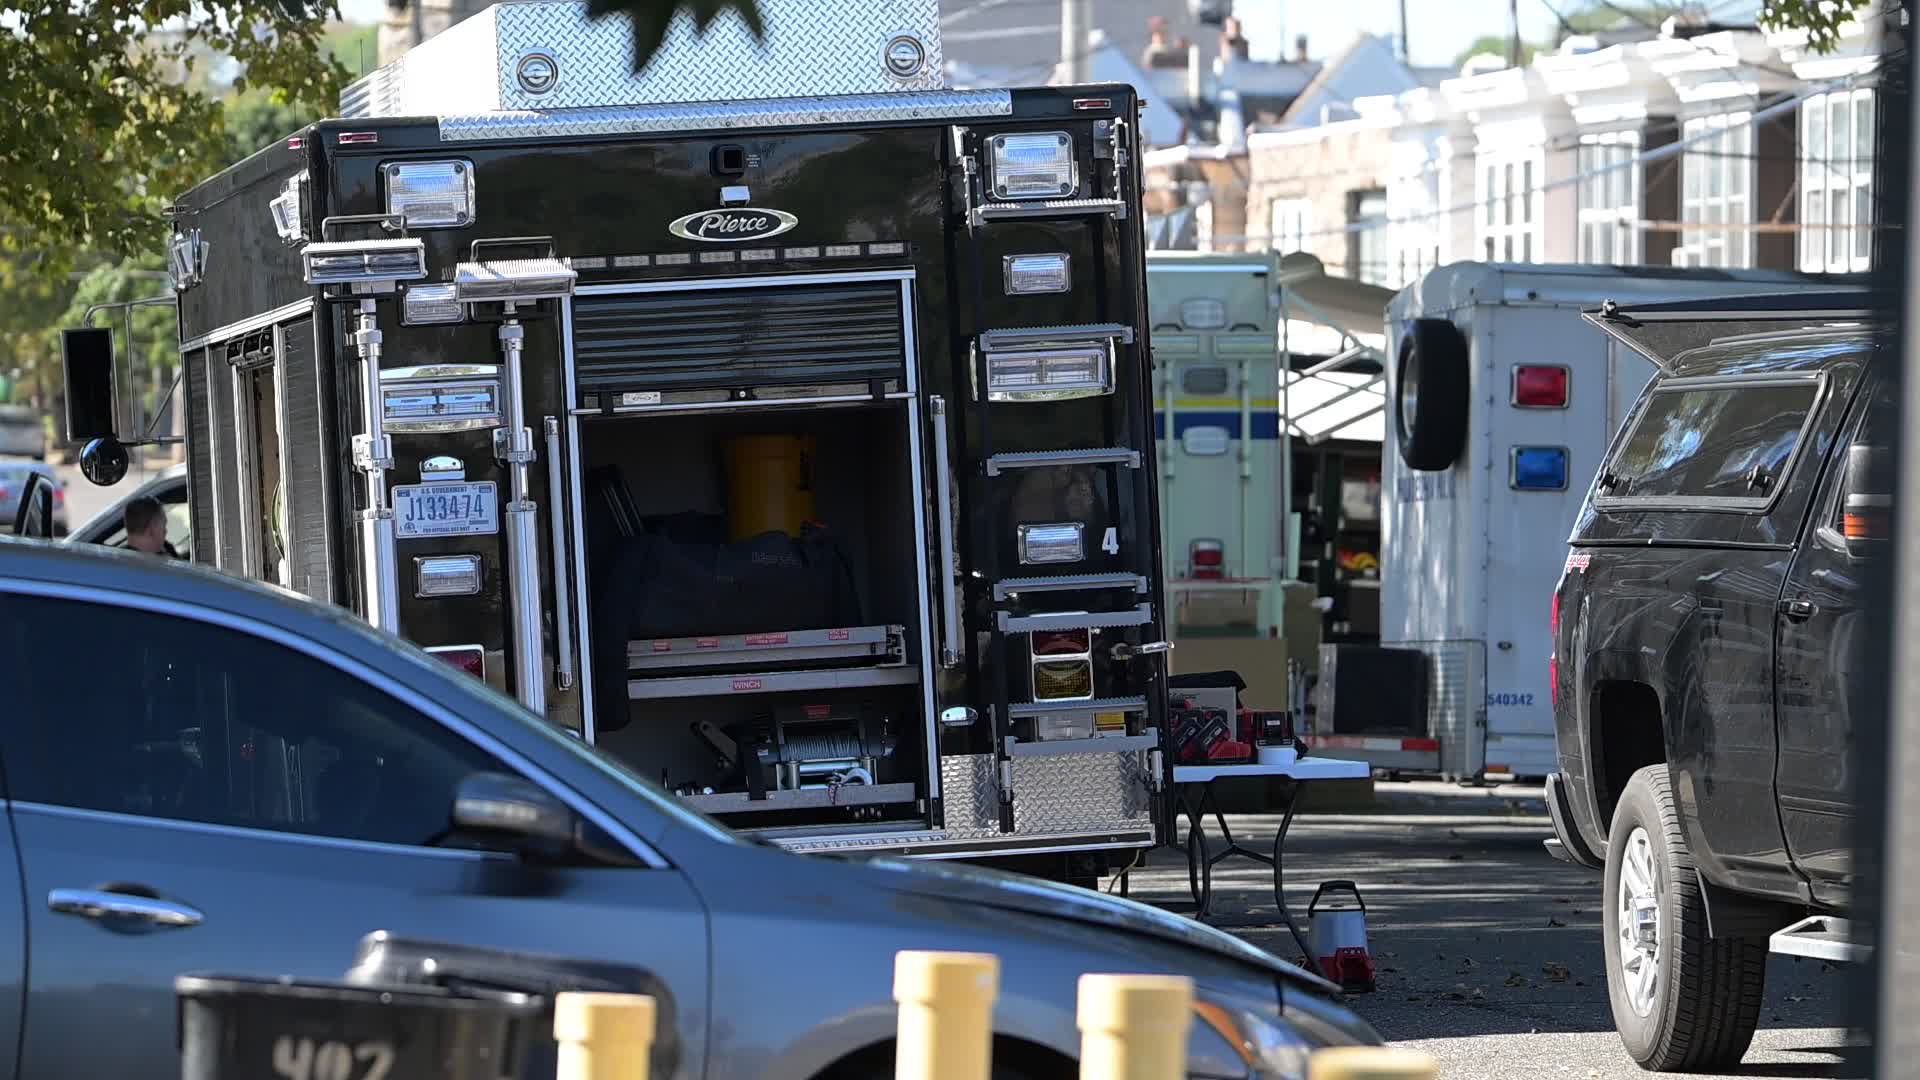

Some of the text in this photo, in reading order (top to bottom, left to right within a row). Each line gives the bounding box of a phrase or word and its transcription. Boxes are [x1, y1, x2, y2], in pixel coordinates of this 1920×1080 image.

[698, 213, 769, 237] Pierce
[405, 495, 484, 521] J133474
[1101, 527, 1119, 555] 4
[733, 680, 761, 689] WINCH
